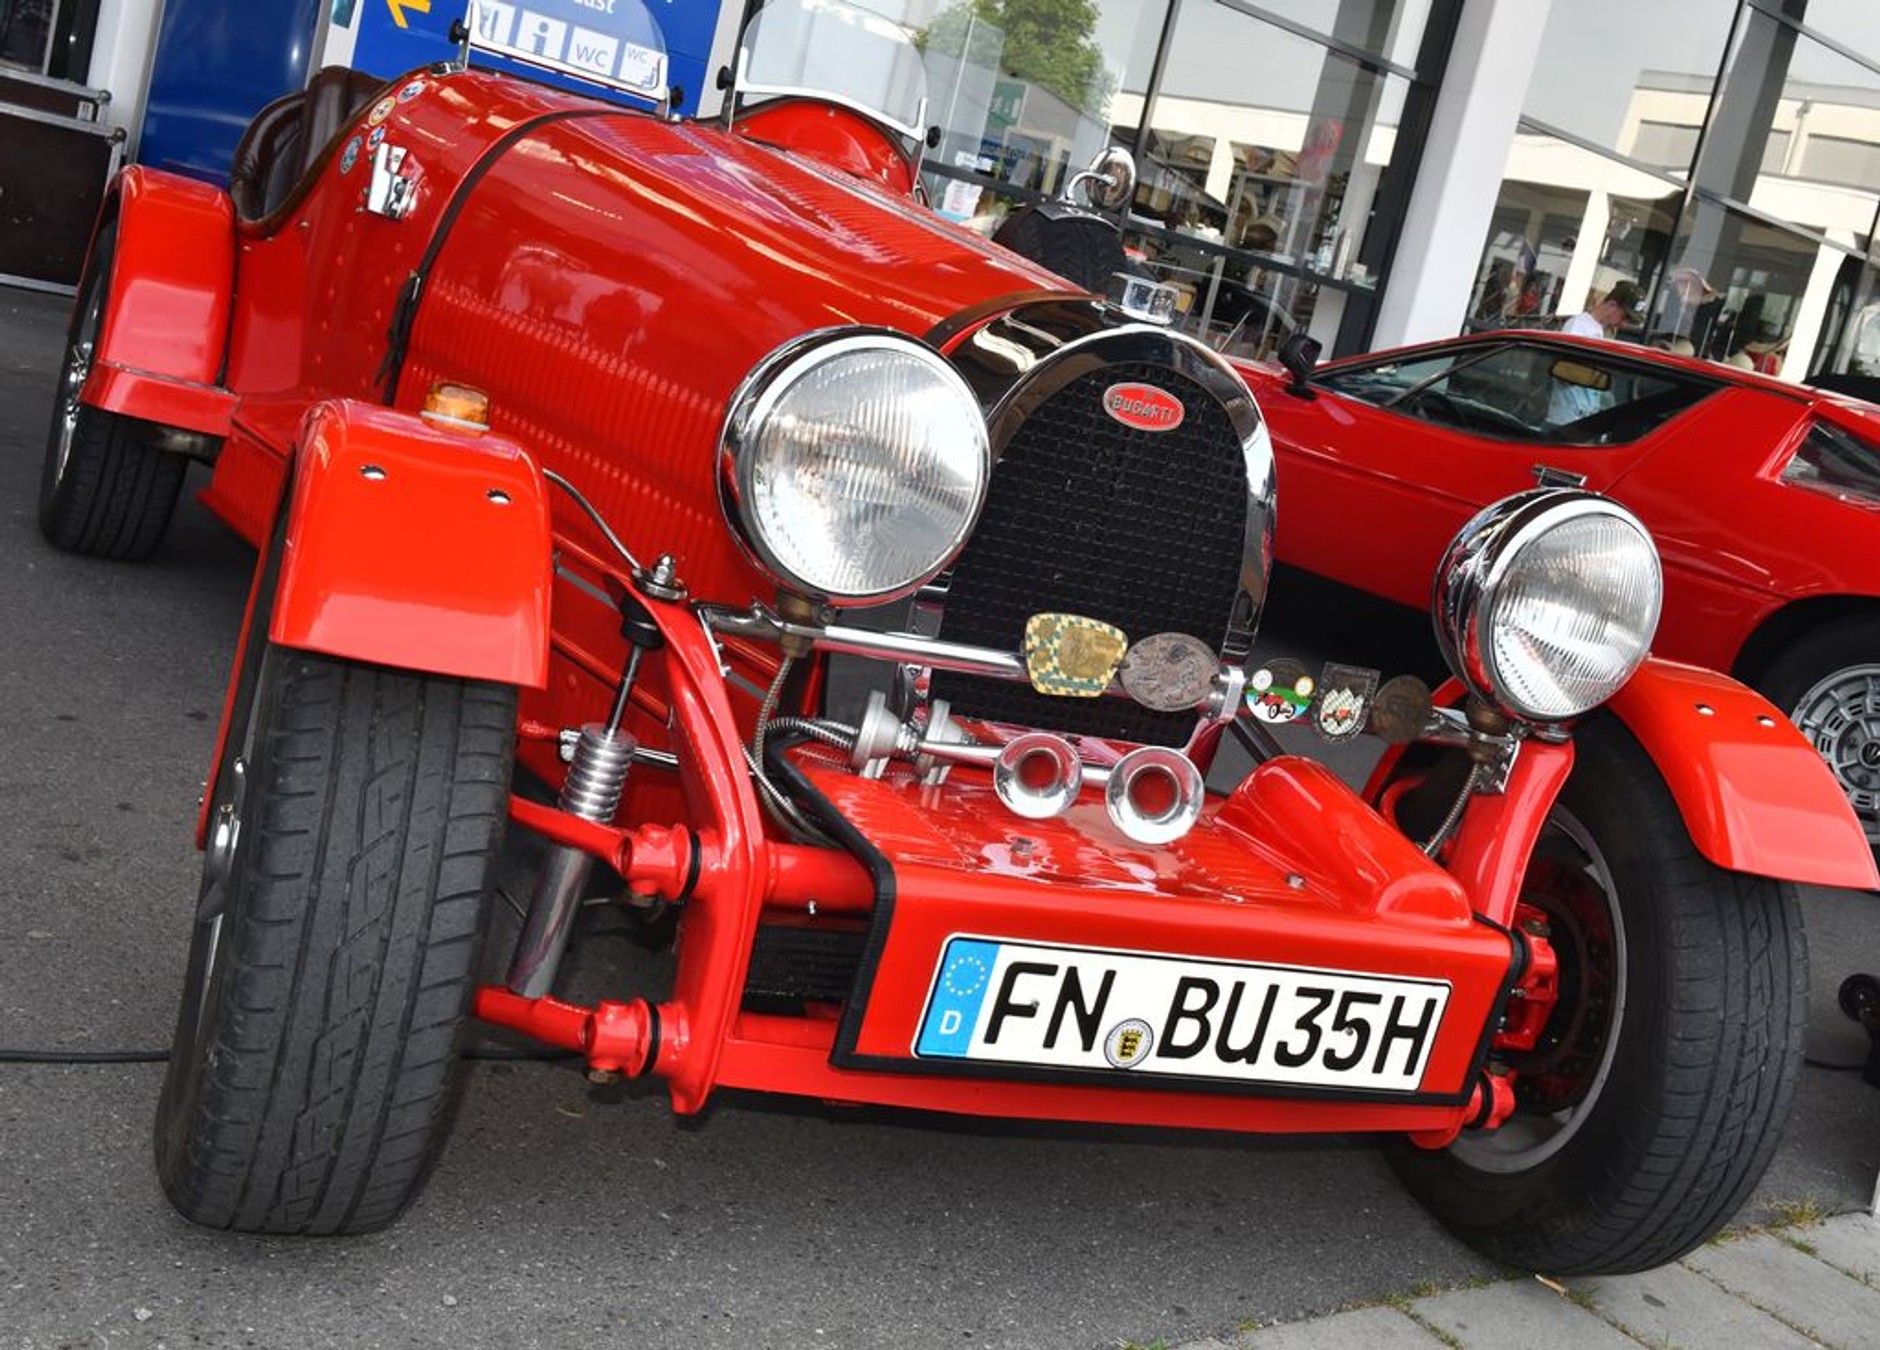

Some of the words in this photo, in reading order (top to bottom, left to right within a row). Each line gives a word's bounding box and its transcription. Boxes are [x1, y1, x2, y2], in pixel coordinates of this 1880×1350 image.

[576, 43, 609, 67] WC
[626, 47, 649, 63] WC
[1110, 394, 1176, 423] BUGATTI
[982, 960, 1117, 1053] FN
[939, 1009, 962, 1036] D
